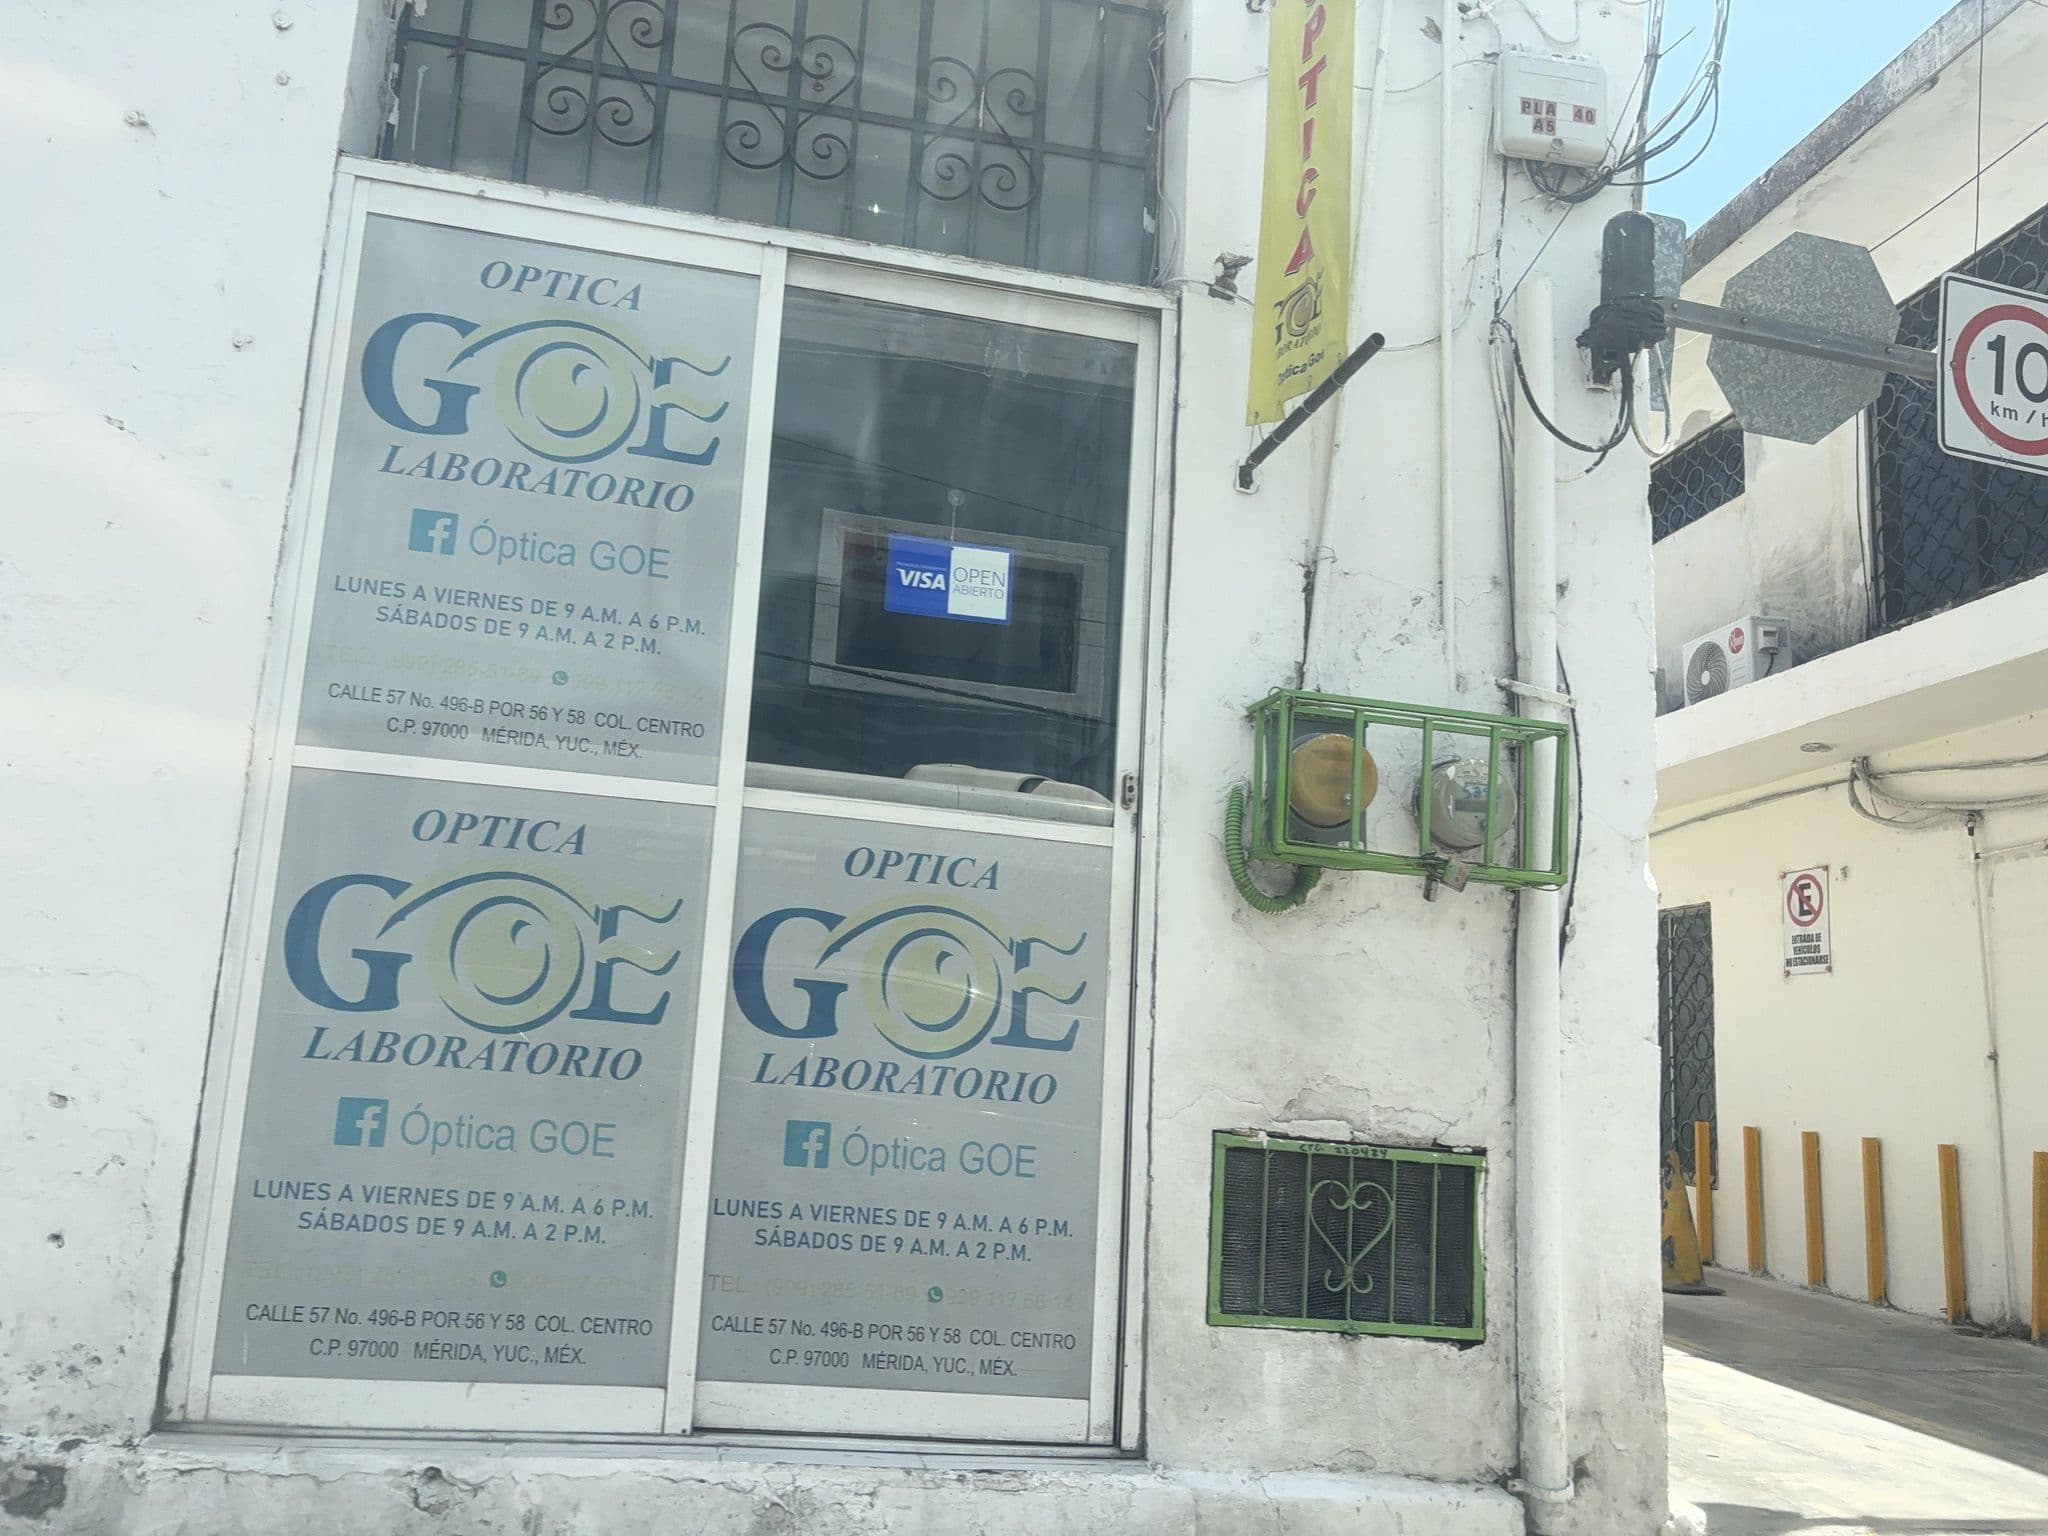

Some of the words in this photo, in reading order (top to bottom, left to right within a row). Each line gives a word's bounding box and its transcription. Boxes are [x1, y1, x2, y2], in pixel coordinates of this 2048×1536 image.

[1284, 0, 1327, 276] PTICA
[1575, 109, 1594, 123] 40
[480, 261, 641, 311] OPTICA
[361, 312, 731, 465] GOE
[1987, 334, 2048, 403] 10
[378, 445, 694, 512] LABORATORIO
[470, 519, 575, 566] Óptica
[590, 541, 670, 579] GOE
[896, 568, 946, 591] VISA
[952, 584, 1005, 600] ABIERTO
[953, 566, 1005, 587] OPEN
[334, 575, 406, 598] LUNES
[412, 585, 426, 601] A
[434, 587, 523, 612] VIERNES
[531, 599, 558, 616] DE
[565, 603, 575, 618] 9
[581, 606, 621, 624] A.M.
[628, 612, 642, 627] A
[649, 614, 659, 629] 6
[667, 616, 705, 636] P.M.
[376, 604, 477, 632] SÁBADOS
[484, 618, 512, 636] DE
[519, 623, 529, 638] 9
[535, 625, 576, 644] A.M.
[583, 631, 597, 647] A
[604, 633, 614, 648] 2
[622, 635, 661, 655] P.M.
[328, 683, 382, 703] CALLE
[386, 689, 406, 704] 57
[440, 696, 484, 713] 496-B
[489, 700, 525, 718] POR
[529, 705, 548, 720] 56
[552, 707, 564, 722] Y
[567, 709, 585, 725] 58
[637, 717, 705, 738] CENTRO
[421, 721, 468, 739] 97000
[412, 810, 586, 855] OPTICA
[844, 847, 998, 890] OPTICA
[284, 872, 683, 1034] GOE
[733, 905, 1087, 1060] GOE
[300, 1027, 642, 1080] LABORATORIO
[751, 1053, 1057, 1104] LABORATORIO
[401, 1103, 517, 1155] Óptica
[530, 1119, 616, 1158] GOE
[843, 1126, 945, 1176] Óptica
[960, 1141, 1036, 1178] GOE
[253, 1179, 331, 1201] LUNES
[338, 1184, 354, 1202] A
[362, 1185, 459, 1207] VIERNES
[466, 1190, 496, 1209] DE
[504, 1193, 514, 1210] 9
[520, 1194, 564, 1213] A.M.
[571, 1197, 585, 1214] A
[593, 1198, 604, 1216] 6
[612, 1199, 653, 1218] P.M.
[713, 1197, 783, 1219] LUNES
[789, 1203, 803, 1220] A
[810, 1204, 897, 1225] VIERNES
[904, 1210, 931, 1228] DE
[937, 1212, 947, 1229] 9
[953, 1213, 992, 1232] A.M.
[999, 1217, 1012, 1233] A
[1019, 1218, 1028, 1234] 6
[1035, 1219, 1073, 1237] P.M.
[298, 1207, 408, 1233] SÁBADOS
[416, 1217, 446, 1235] DE
[454, 1219, 464, 1236] 9
[472, 1220, 516, 1239] A.M.
[522, 1222, 537, 1240] A
[545, 1224, 556, 1241] 2
[564, 1224, 605, 1244] P.M.
[754, 1225, 853, 1250] SÁBADOS
[860, 1235, 887, 1252] DE
[894, 1237, 904, 1253] 9
[910, 1238, 949, 1256] A.M.
[956, 1241, 969, 1257] A
[976, 1242, 986, 1259] 2
[993, 1243, 1031, 1262] P.M.
[246, 1304, 305, 1322] CALLE
[309, 1307, 330, 1323] 57
[368, 1309, 416, 1326] 496-B
[421, 1311, 460, 1328] POR
[465, 1313, 487, 1329] 56
[489, 1313, 502, 1329] Y
[505, 1314, 525, 1330] 58
[580, 1317, 653, 1336] CENTRO
[711, 1315, 764, 1333] CALLE
[768, 1319, 787, 1334] 57
[820, 1321, 864, 1338] 496-B
[868, 1324, 902, 1341] POR
[907, 1326, 925, 1342] 56
[929, 1327, 940, 1342] Y
[943, 1328, 961, 1344] 58
[1011, 1331, 1076, 1350] CENTRO
[347, 1340, 399, 1358] 97000
[804, 1350, 849, 1368] 97000
